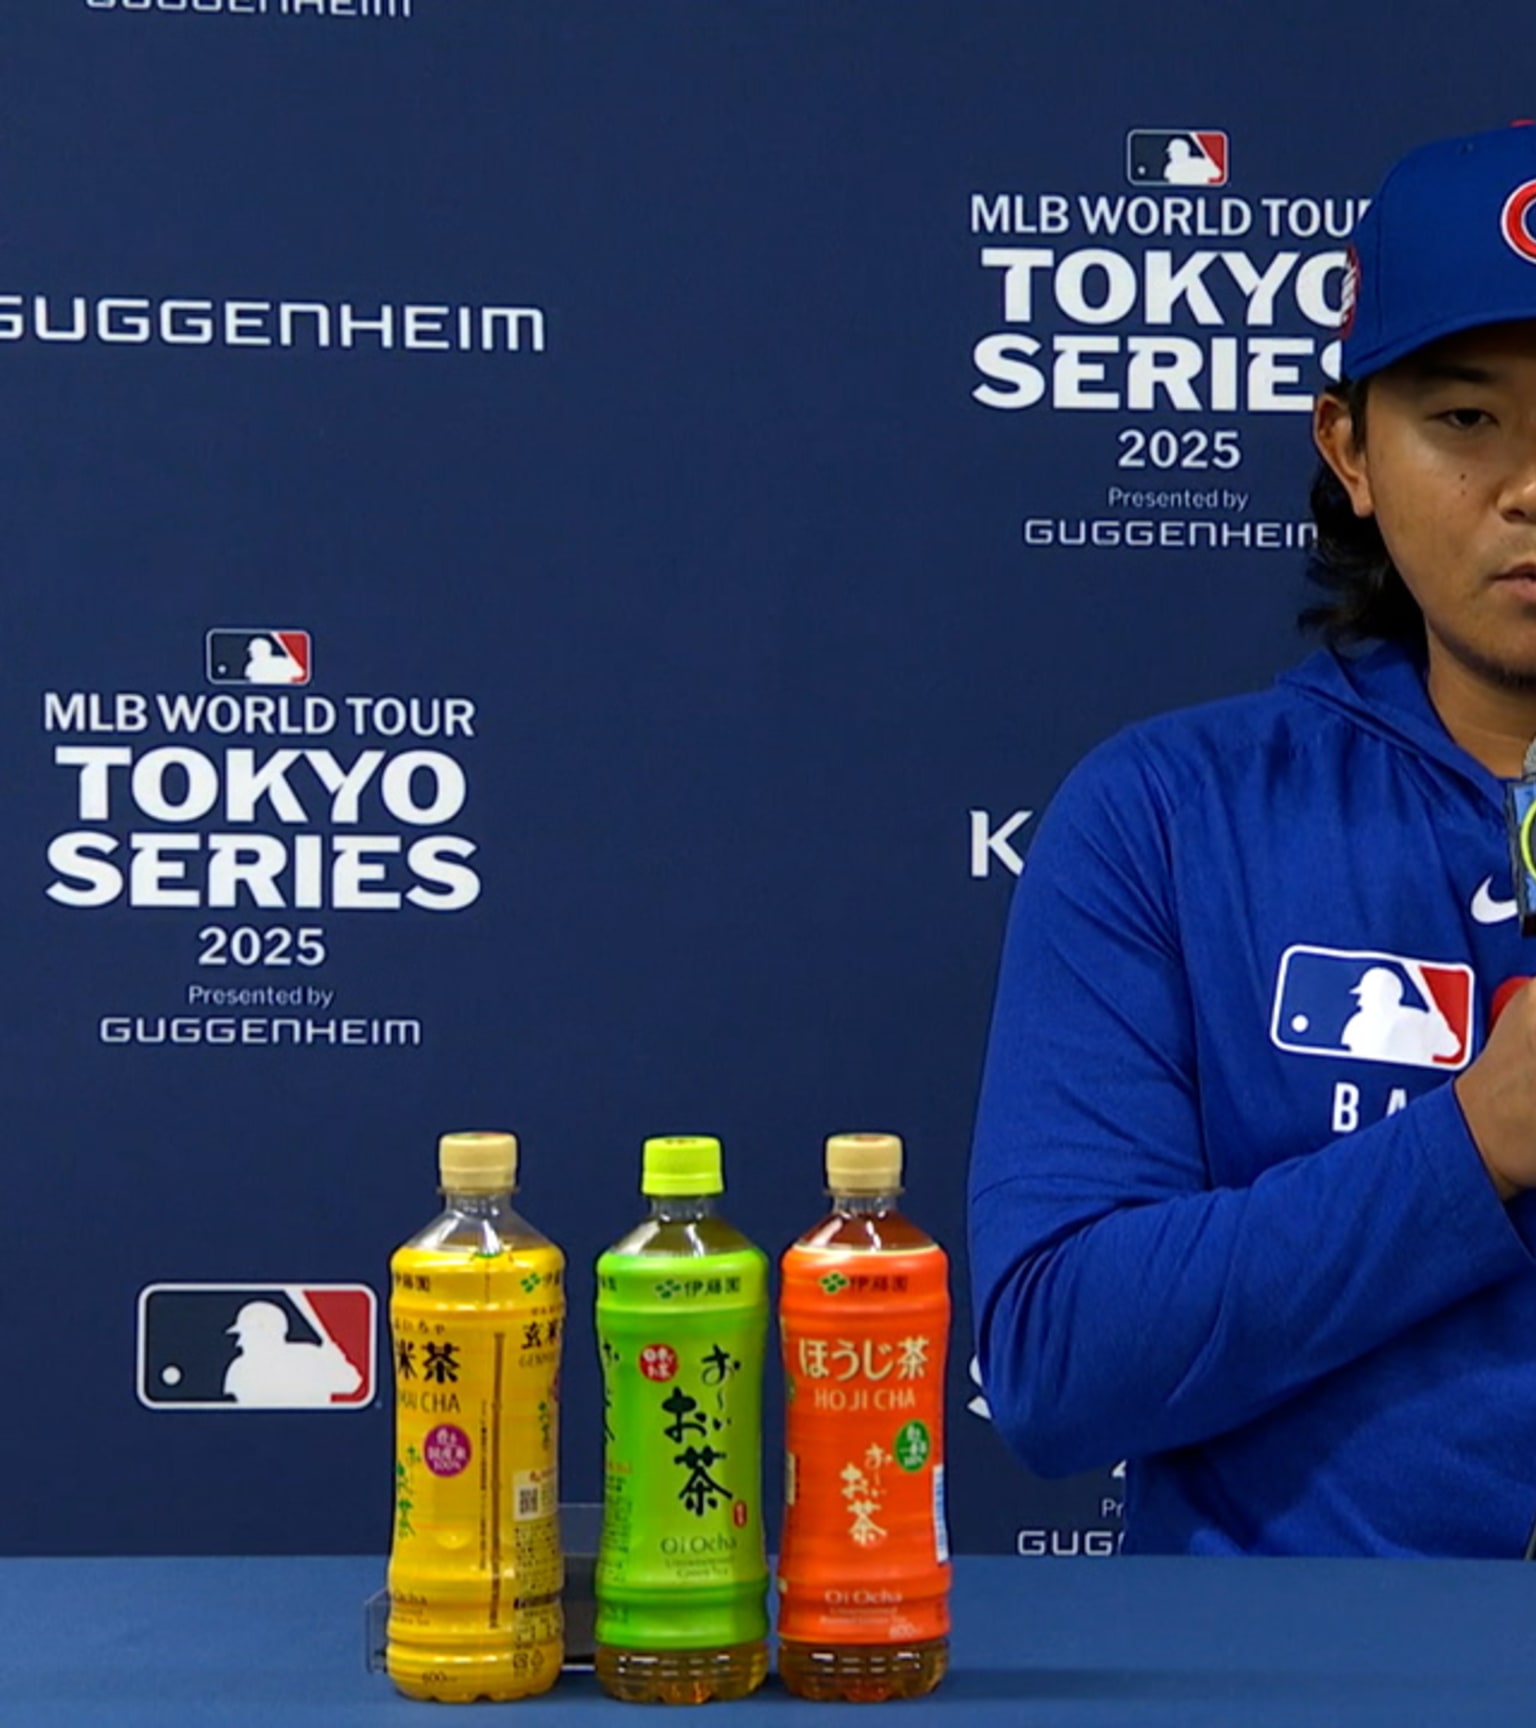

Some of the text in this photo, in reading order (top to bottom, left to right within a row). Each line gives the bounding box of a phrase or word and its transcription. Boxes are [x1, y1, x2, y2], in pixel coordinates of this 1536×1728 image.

[972, 195, 1068, 232] MLB
[1080, 197, 1251, 235] WORLD
[981, 248, 1346, 328] TOKYO
[1118, 429, 1240, 468] 2025
[1108, 487, 1248, 513] Presented by
[46, 694, 474, 735] MLB WORLD TOUR
[55, 746, 466, 825] TOKYO
[46, 831, 480, 910] SERIES
[199, 927, 325, 966] 2025
[188, 985, 333, 1009] Presented by
[100, 1017, 420, 1045] GUGGENHEIM
[798, 1335, 930, 1382] ほうじ茶
[420, 1391, 462, 1414] CHA
[872, 1387, 917, 1411] CHA
[853, 1588, 903, 1605] Ocha
